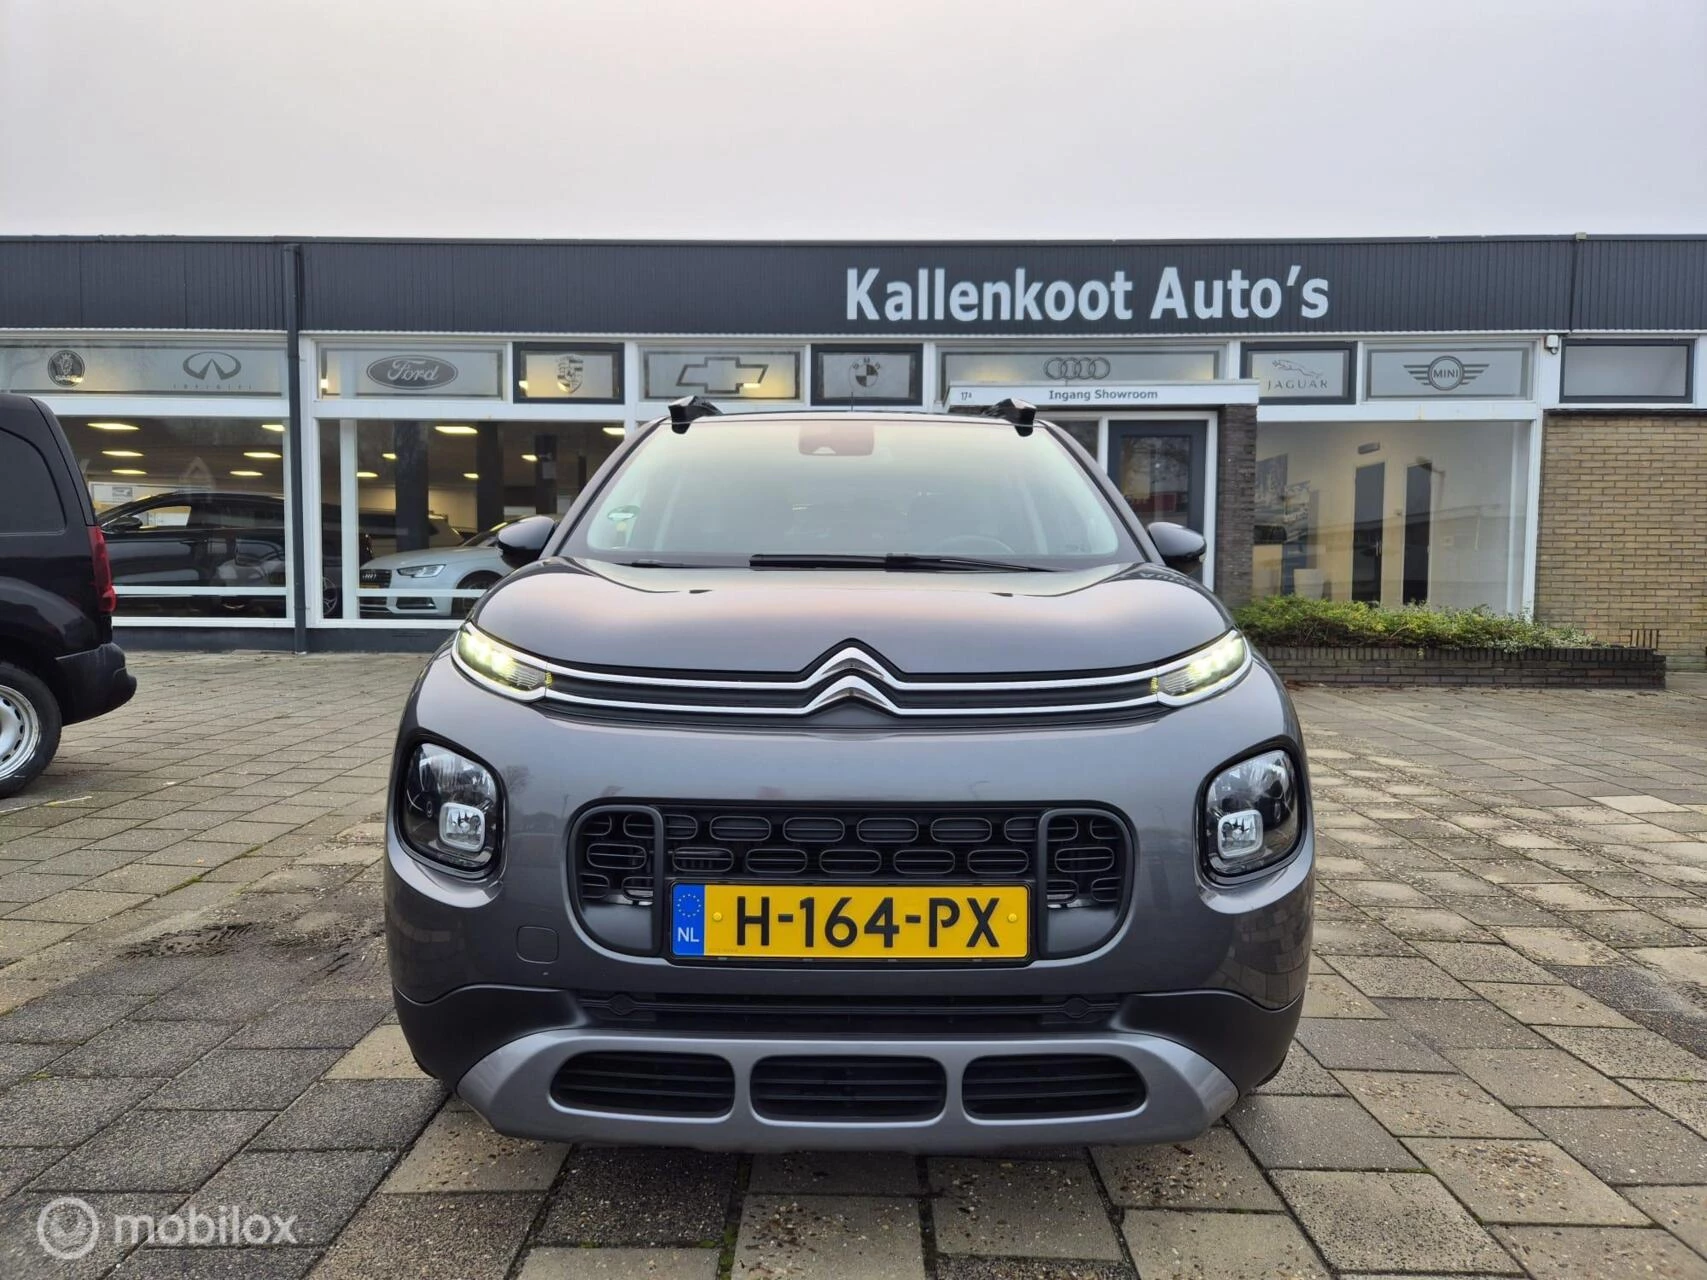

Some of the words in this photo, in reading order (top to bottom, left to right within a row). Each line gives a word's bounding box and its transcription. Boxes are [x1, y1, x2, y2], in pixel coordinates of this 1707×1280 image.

[846, 267, 1133, 321] Kallenkoot
[387, 360, 440, 381] Ford
[1433, 369, 1459, 378] MINI
[1268, 380, 1328, 391] JAGUAR
[1049, 390, 1091, 401] Ingang
[1095, 389, 1158, 400] Showroom
[736, 896, 1000, 948] H-164-PX
[677, 926, 700, 943] NL
